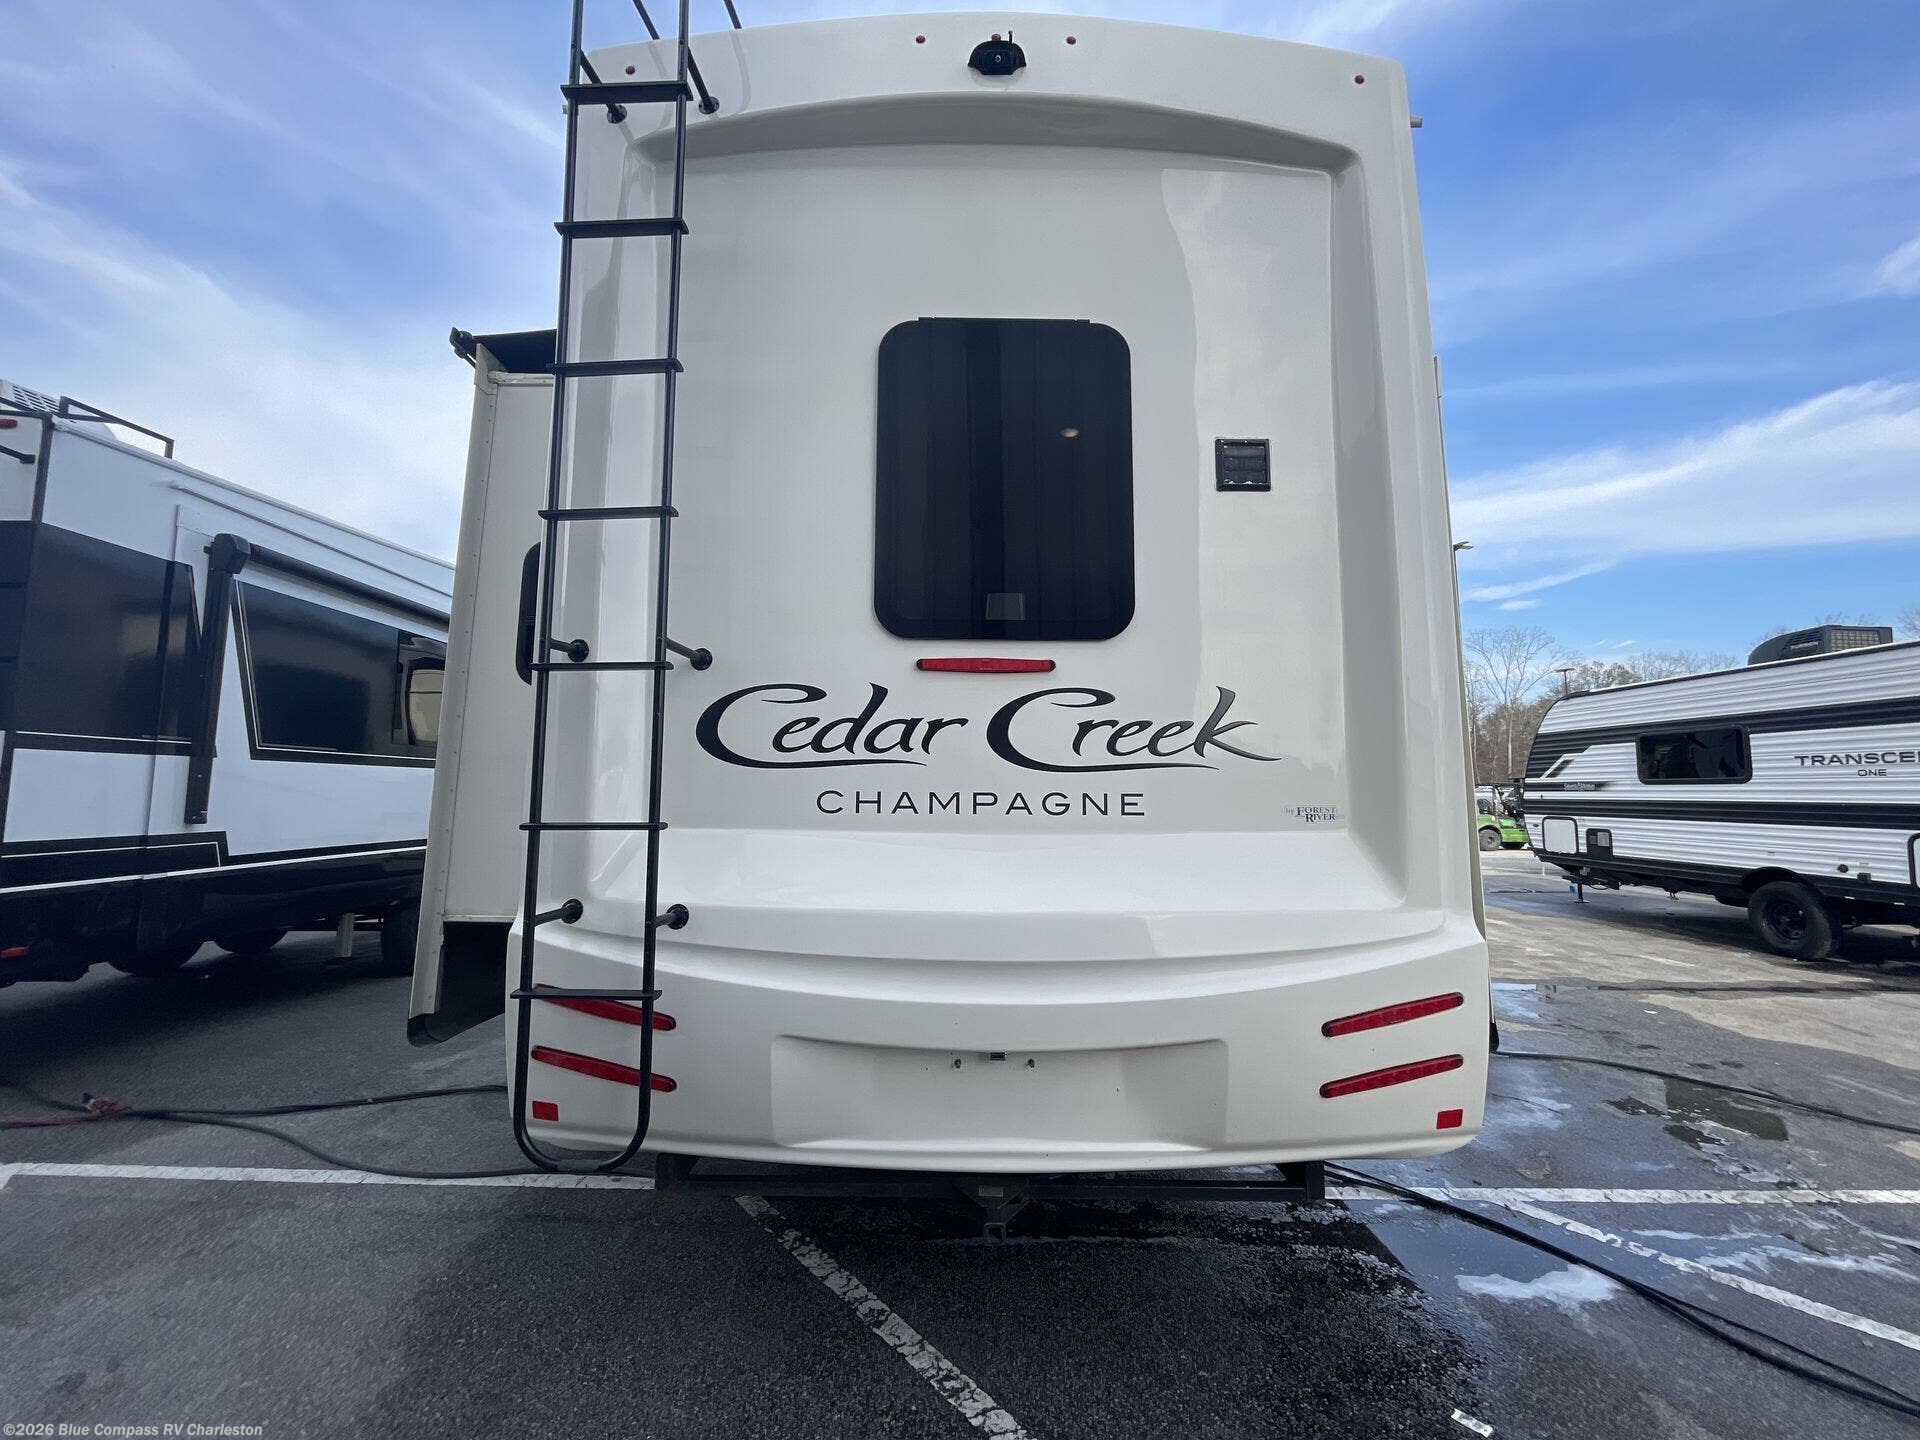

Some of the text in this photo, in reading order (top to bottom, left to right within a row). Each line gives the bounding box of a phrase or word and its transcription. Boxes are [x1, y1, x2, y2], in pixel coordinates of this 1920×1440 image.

[695, 683, 1283, 773] Cedar Creek
[1794, 751, 1920, 766] TRANSCE
[1857, 769, 1887, 777] ONE
[816, 790, 1145, 816] CHAMPAGNE
[1305, 813, 1336, 823] RIVER
